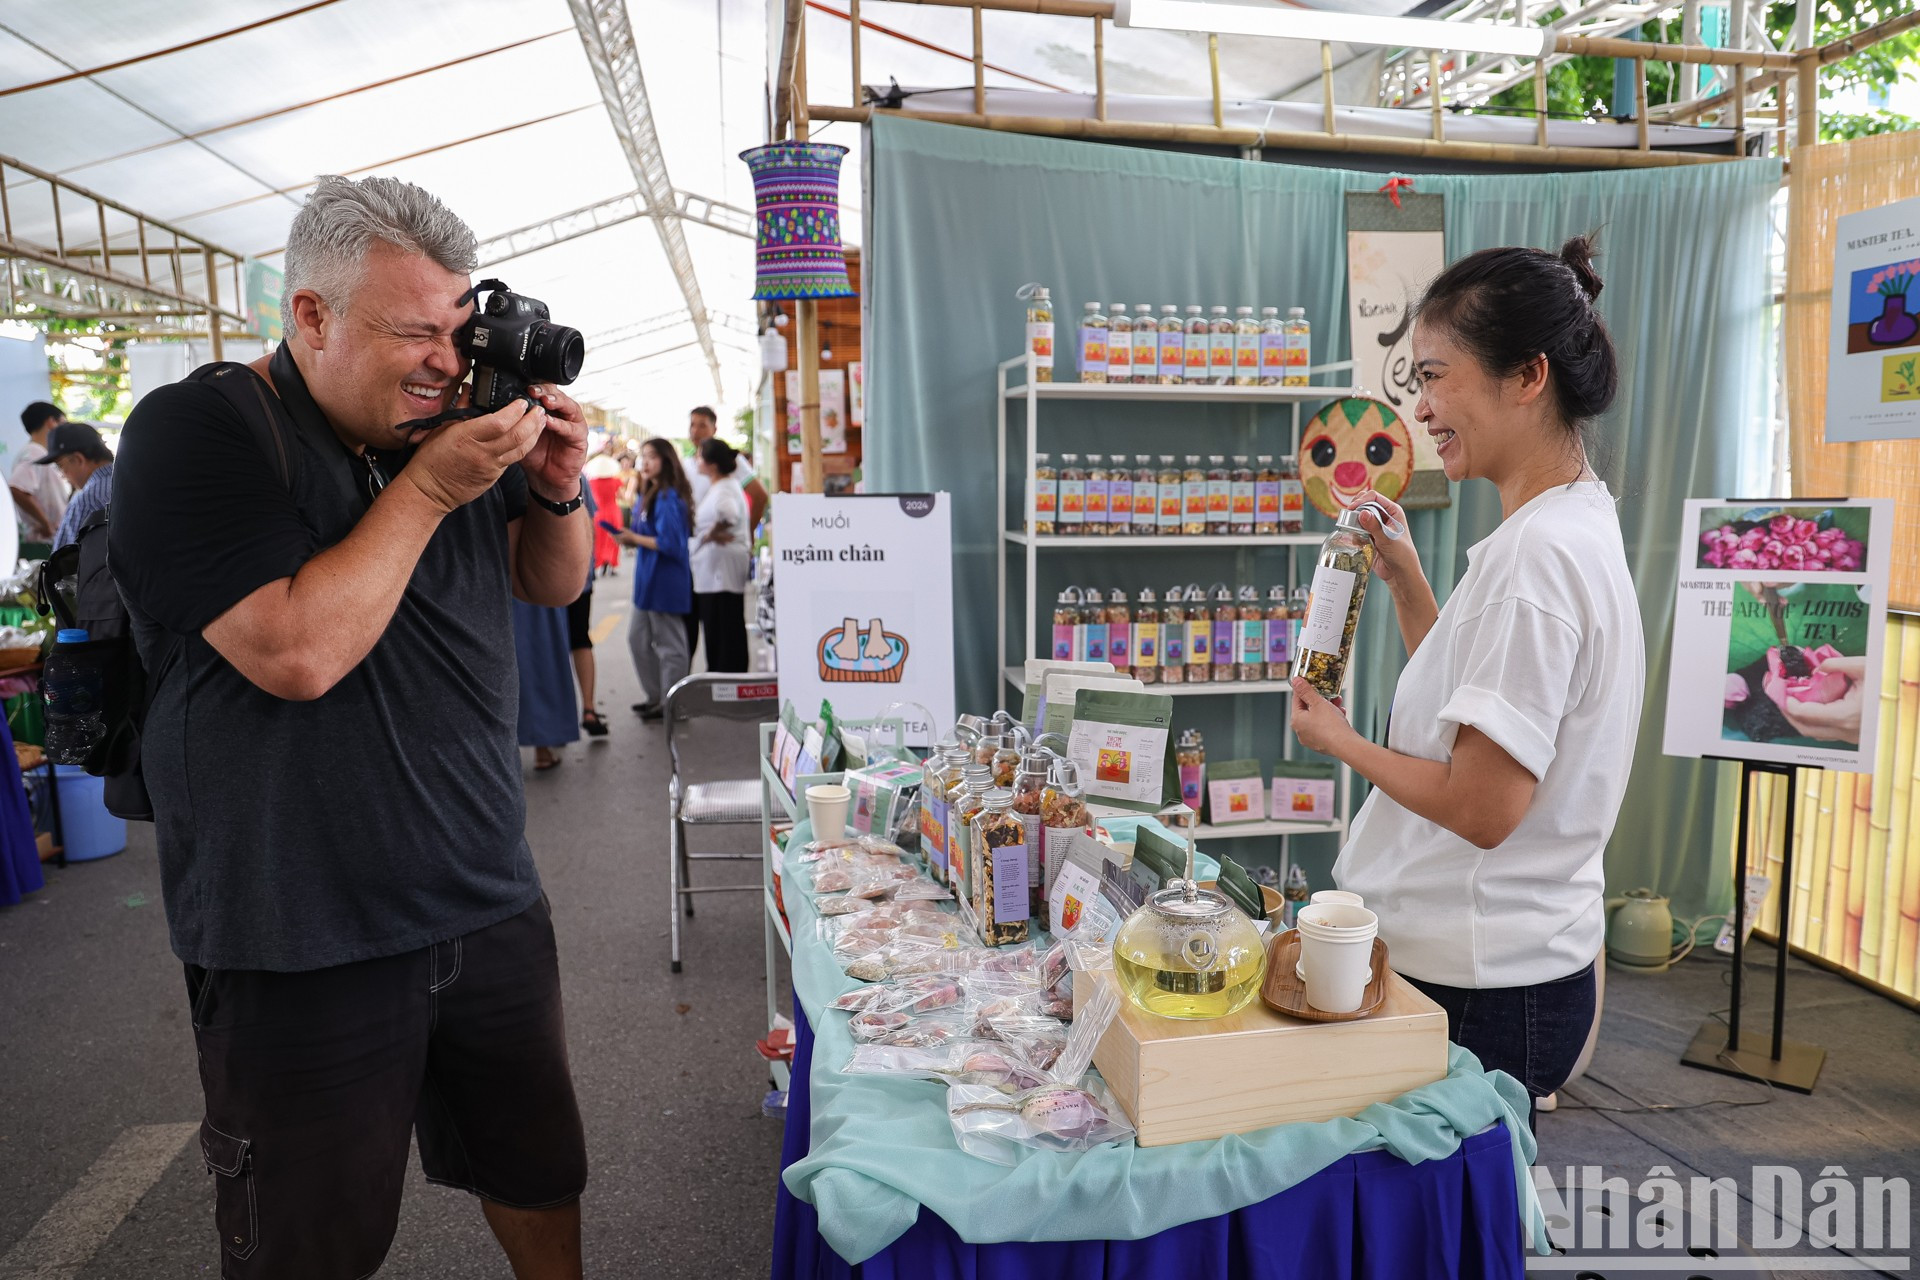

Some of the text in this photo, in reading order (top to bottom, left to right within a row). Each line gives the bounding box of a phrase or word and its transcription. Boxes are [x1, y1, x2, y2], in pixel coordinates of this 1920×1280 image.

[519, 333, 529, 361] Canon
[905, 500, 928, 510] 2024
[782, 543, 885, 565] ngâm chân
[1680, 581, 1731, 590] MASTER TEA
[1701, 600, 1863, 619] THE ART OF LOTUS
[1803, 623, 1838, 640] TEA
[903, 721, 928, 733] TEA
